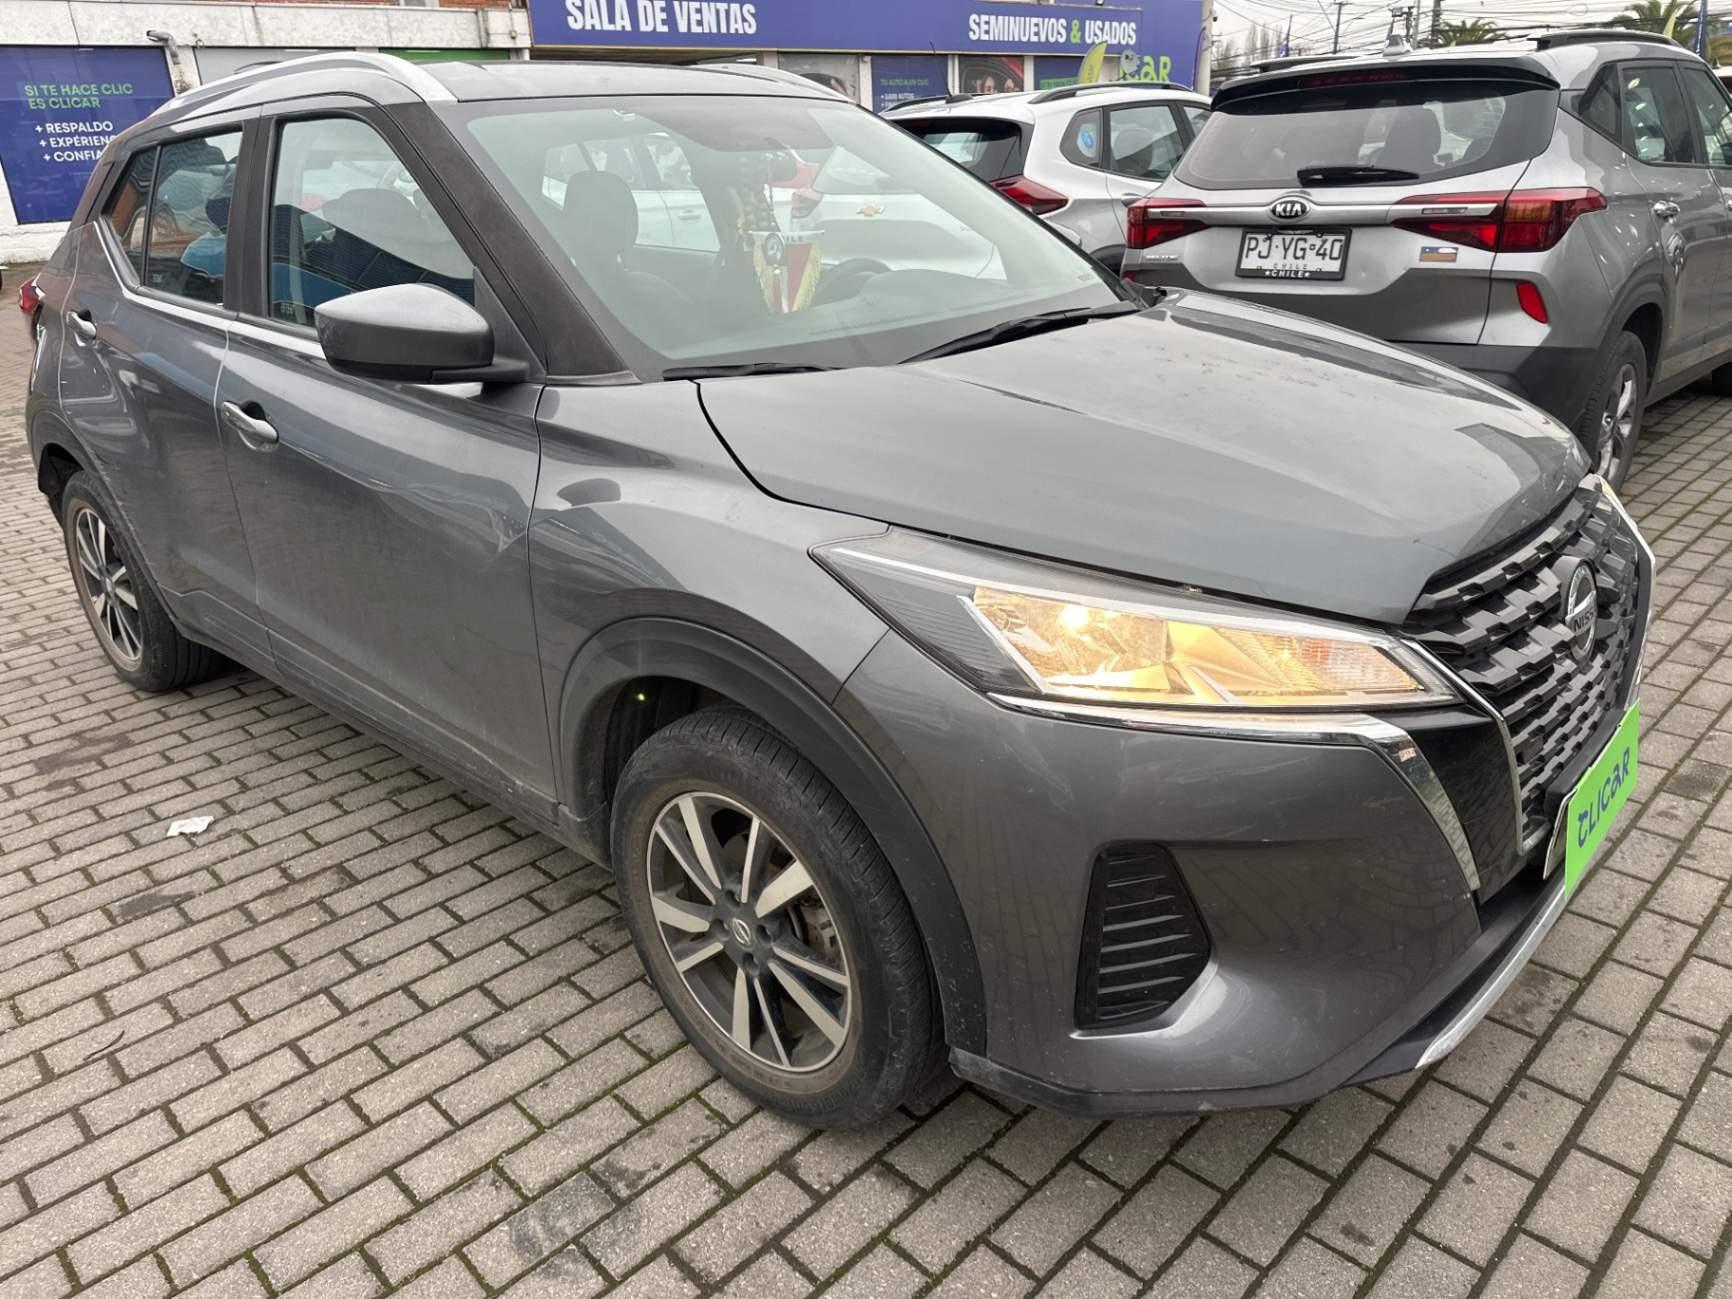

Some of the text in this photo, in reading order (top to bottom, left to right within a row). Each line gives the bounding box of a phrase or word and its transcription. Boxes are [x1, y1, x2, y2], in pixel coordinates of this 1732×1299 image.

[565, 0, 757, 35] SALA DE VENTAS
[968, 13, 1137, 45] SEMINUEVOS & USADOS
[24, 83, 134, 97] SI TE HACE CLIC
[28, 97, 101, 109] ES CLICAR
[45, 121, 113, 134] RESPALDO
[1275, 202, 1302, 217] KIA
